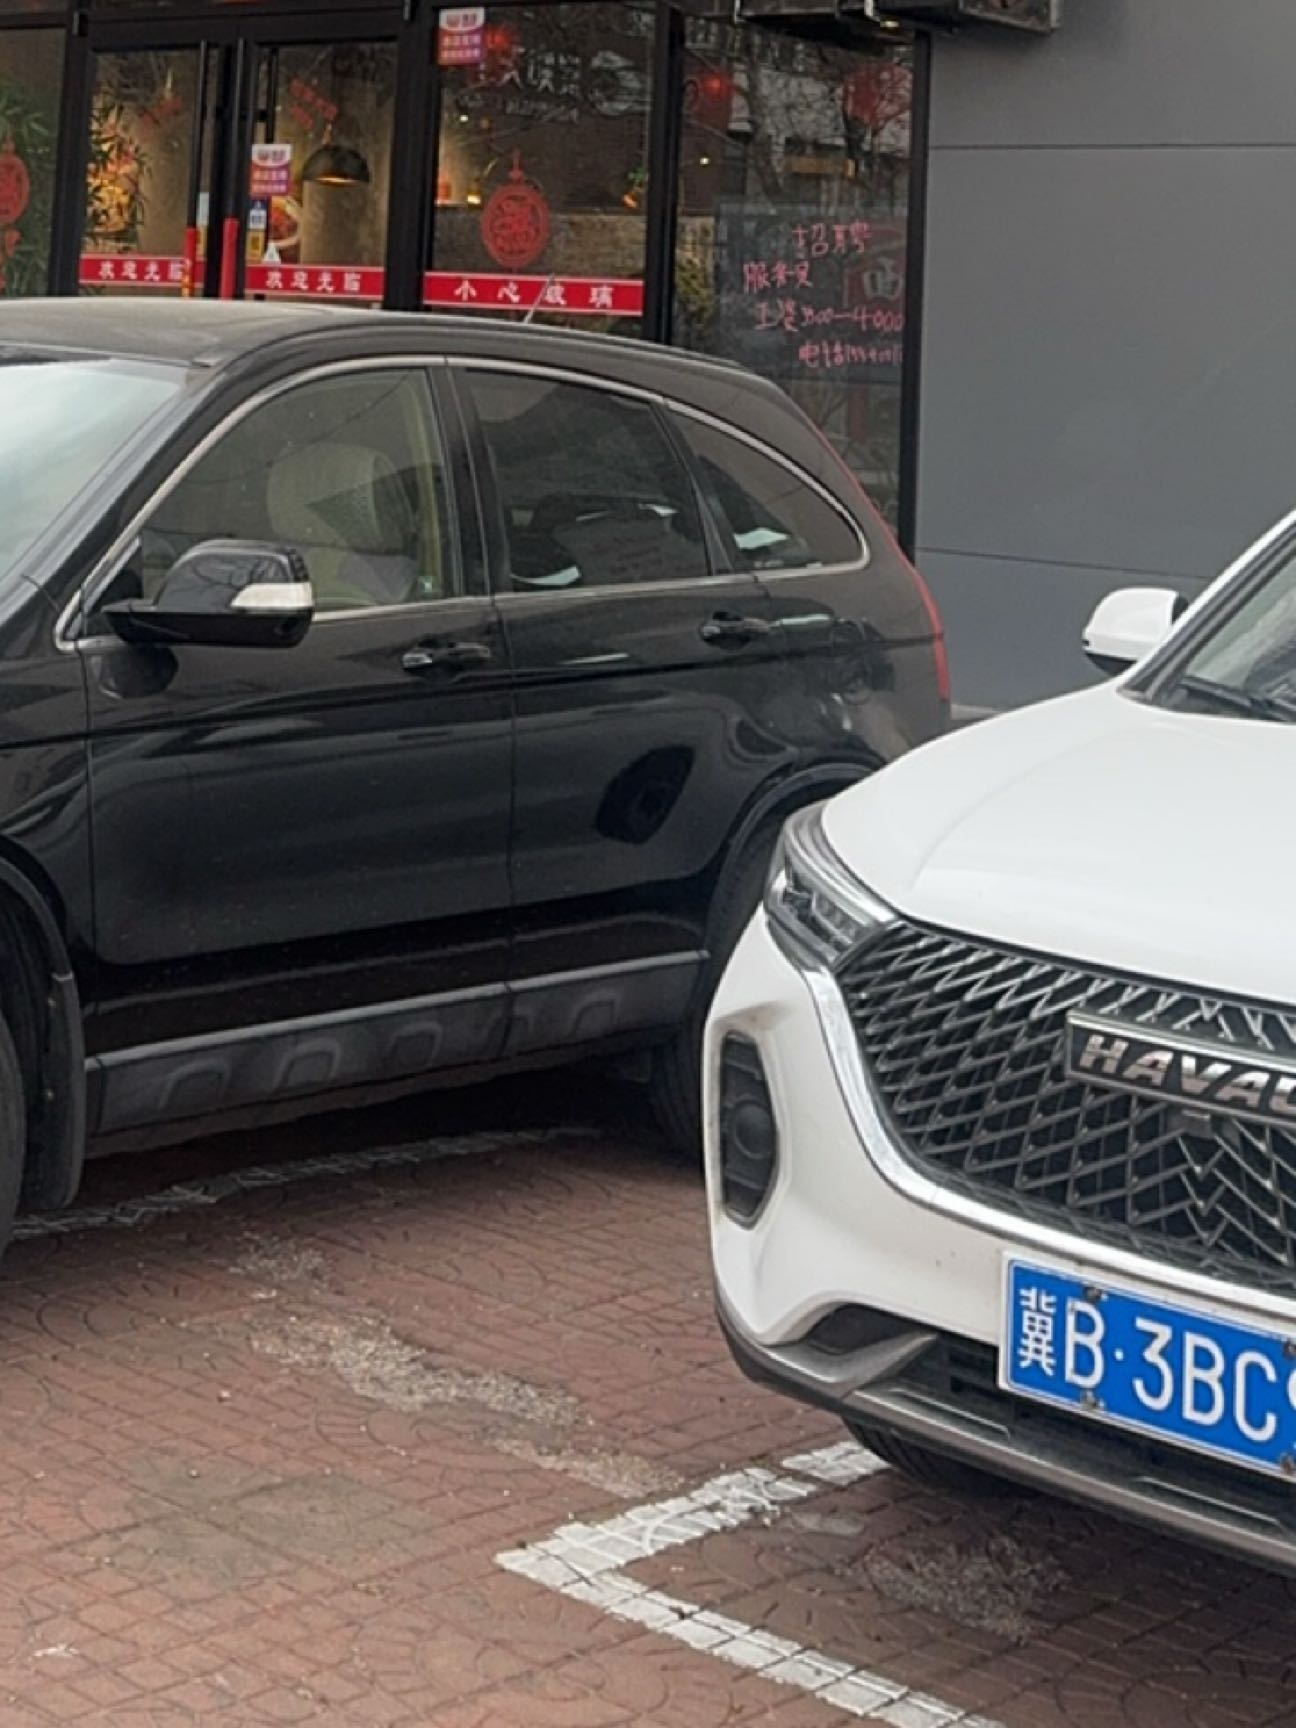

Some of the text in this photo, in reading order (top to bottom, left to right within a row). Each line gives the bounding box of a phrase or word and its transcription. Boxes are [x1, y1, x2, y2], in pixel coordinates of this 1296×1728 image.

[266, 270, 362, 292] 欢迎光临
[454, 279, 614, 308] 小心玻璃
